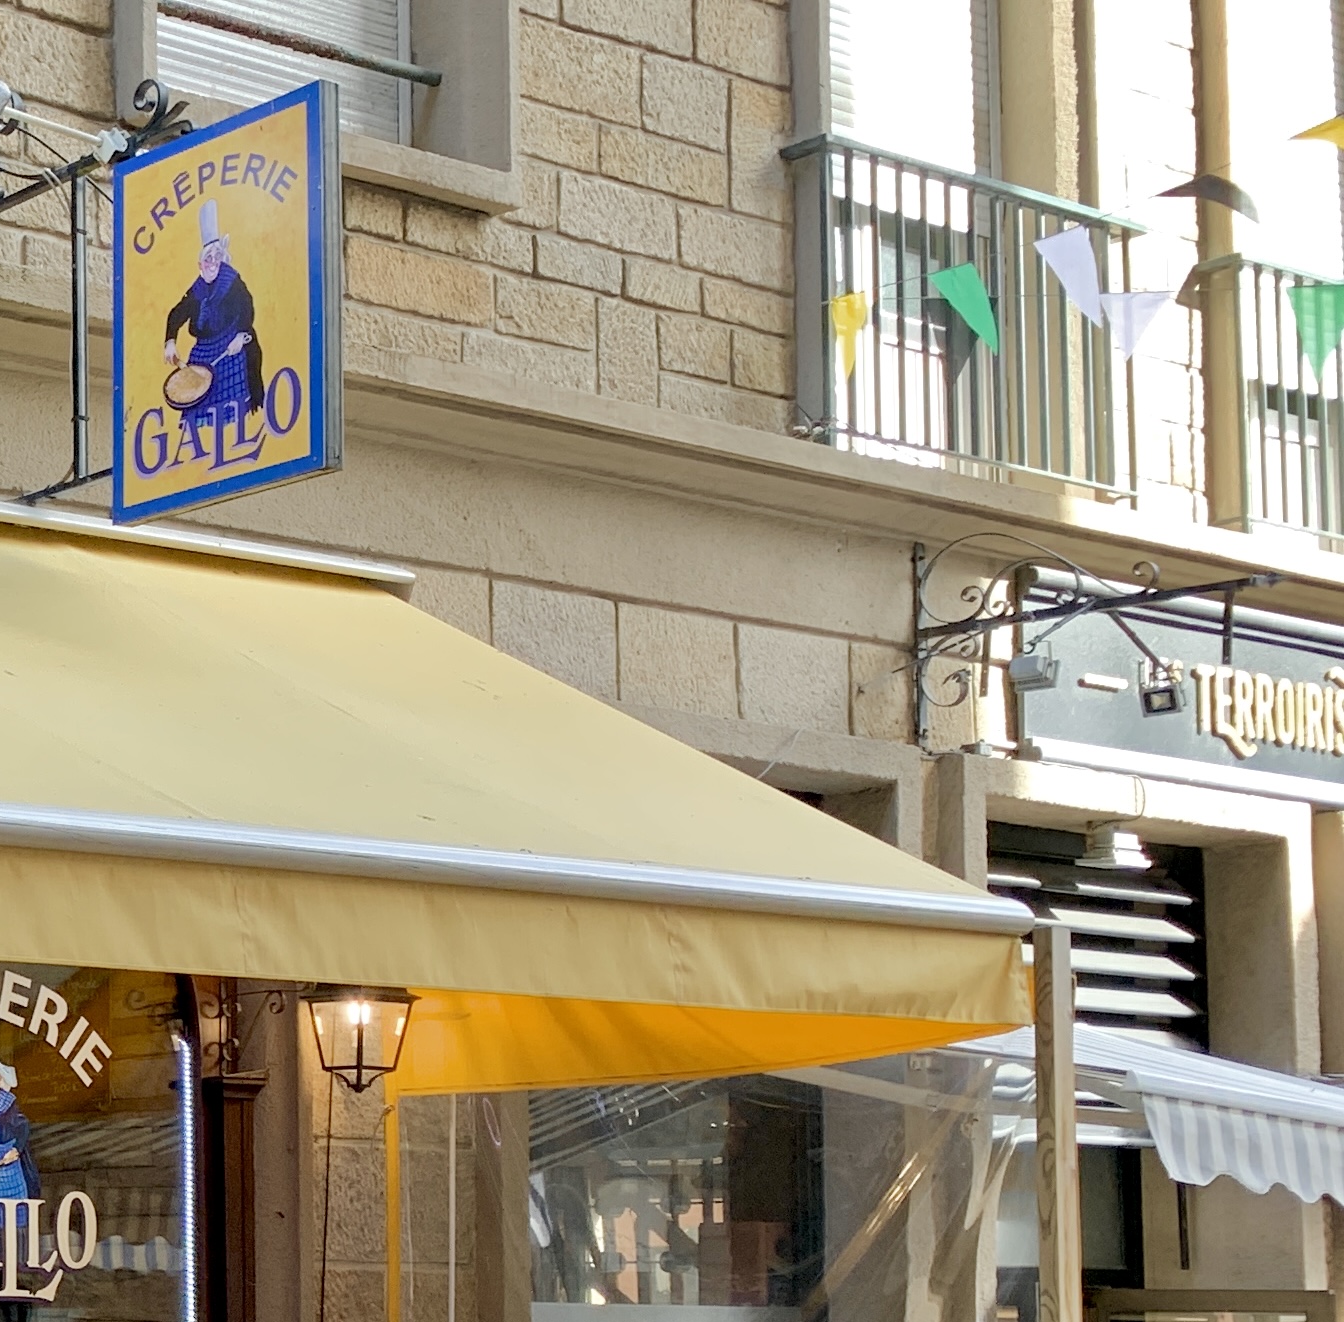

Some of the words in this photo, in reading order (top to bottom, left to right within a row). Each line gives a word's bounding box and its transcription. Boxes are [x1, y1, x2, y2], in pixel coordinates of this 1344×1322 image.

[132, 152, 298, 255] CRÊPERIE
[132, 366, 303, 479] GALLO
[1191, 663, 1344, 760] TERROIRIS
